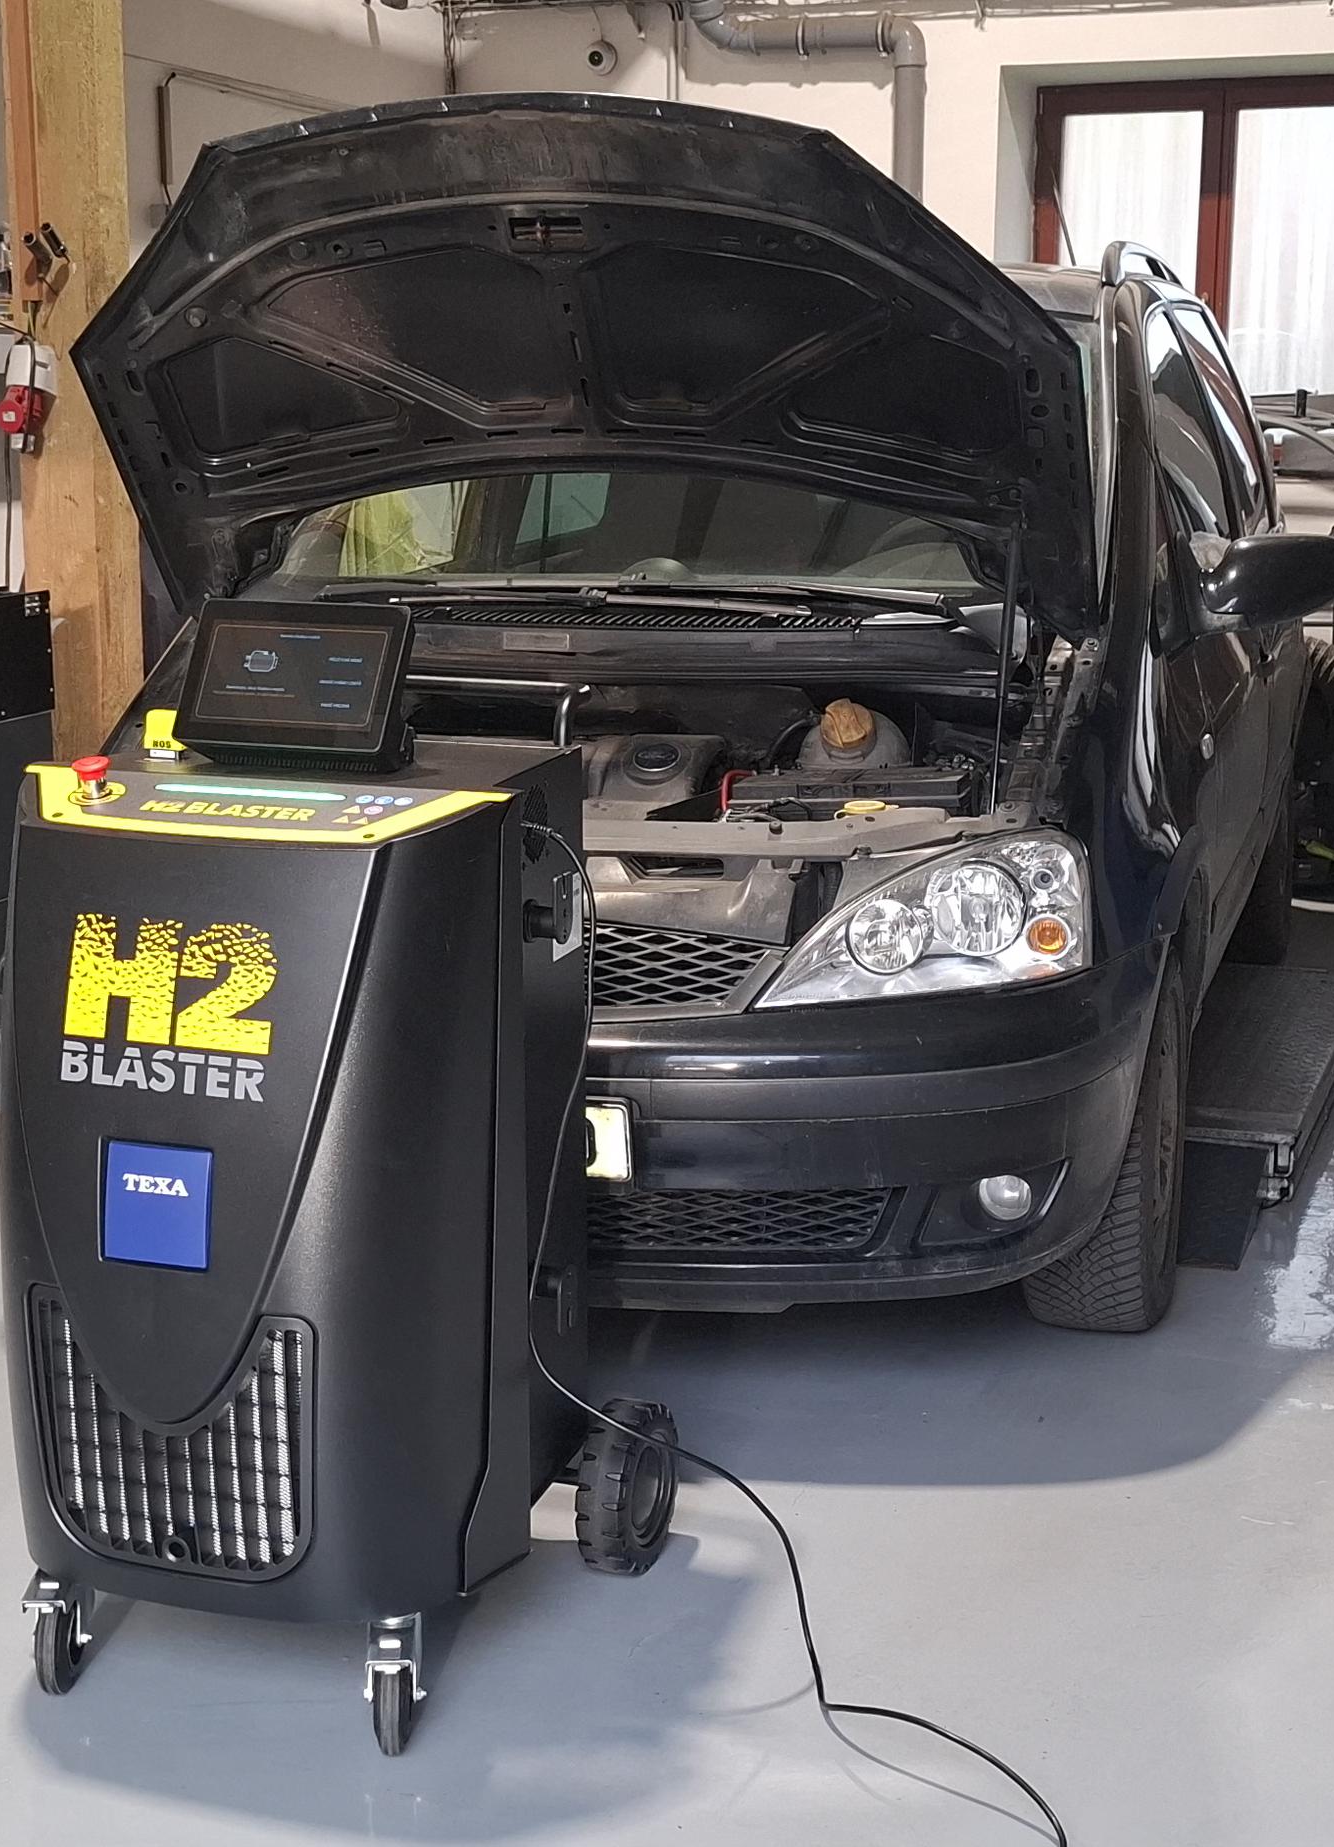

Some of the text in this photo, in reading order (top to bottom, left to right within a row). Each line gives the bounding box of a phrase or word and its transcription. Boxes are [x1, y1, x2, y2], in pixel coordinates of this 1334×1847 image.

[139, 799, 316, 821] H2 BLASTER
[64, 913, 278, 1056] H2
[61, 1039, 266, 1102] BLASTER
[122, 1173, 189, 1197] TEXA
